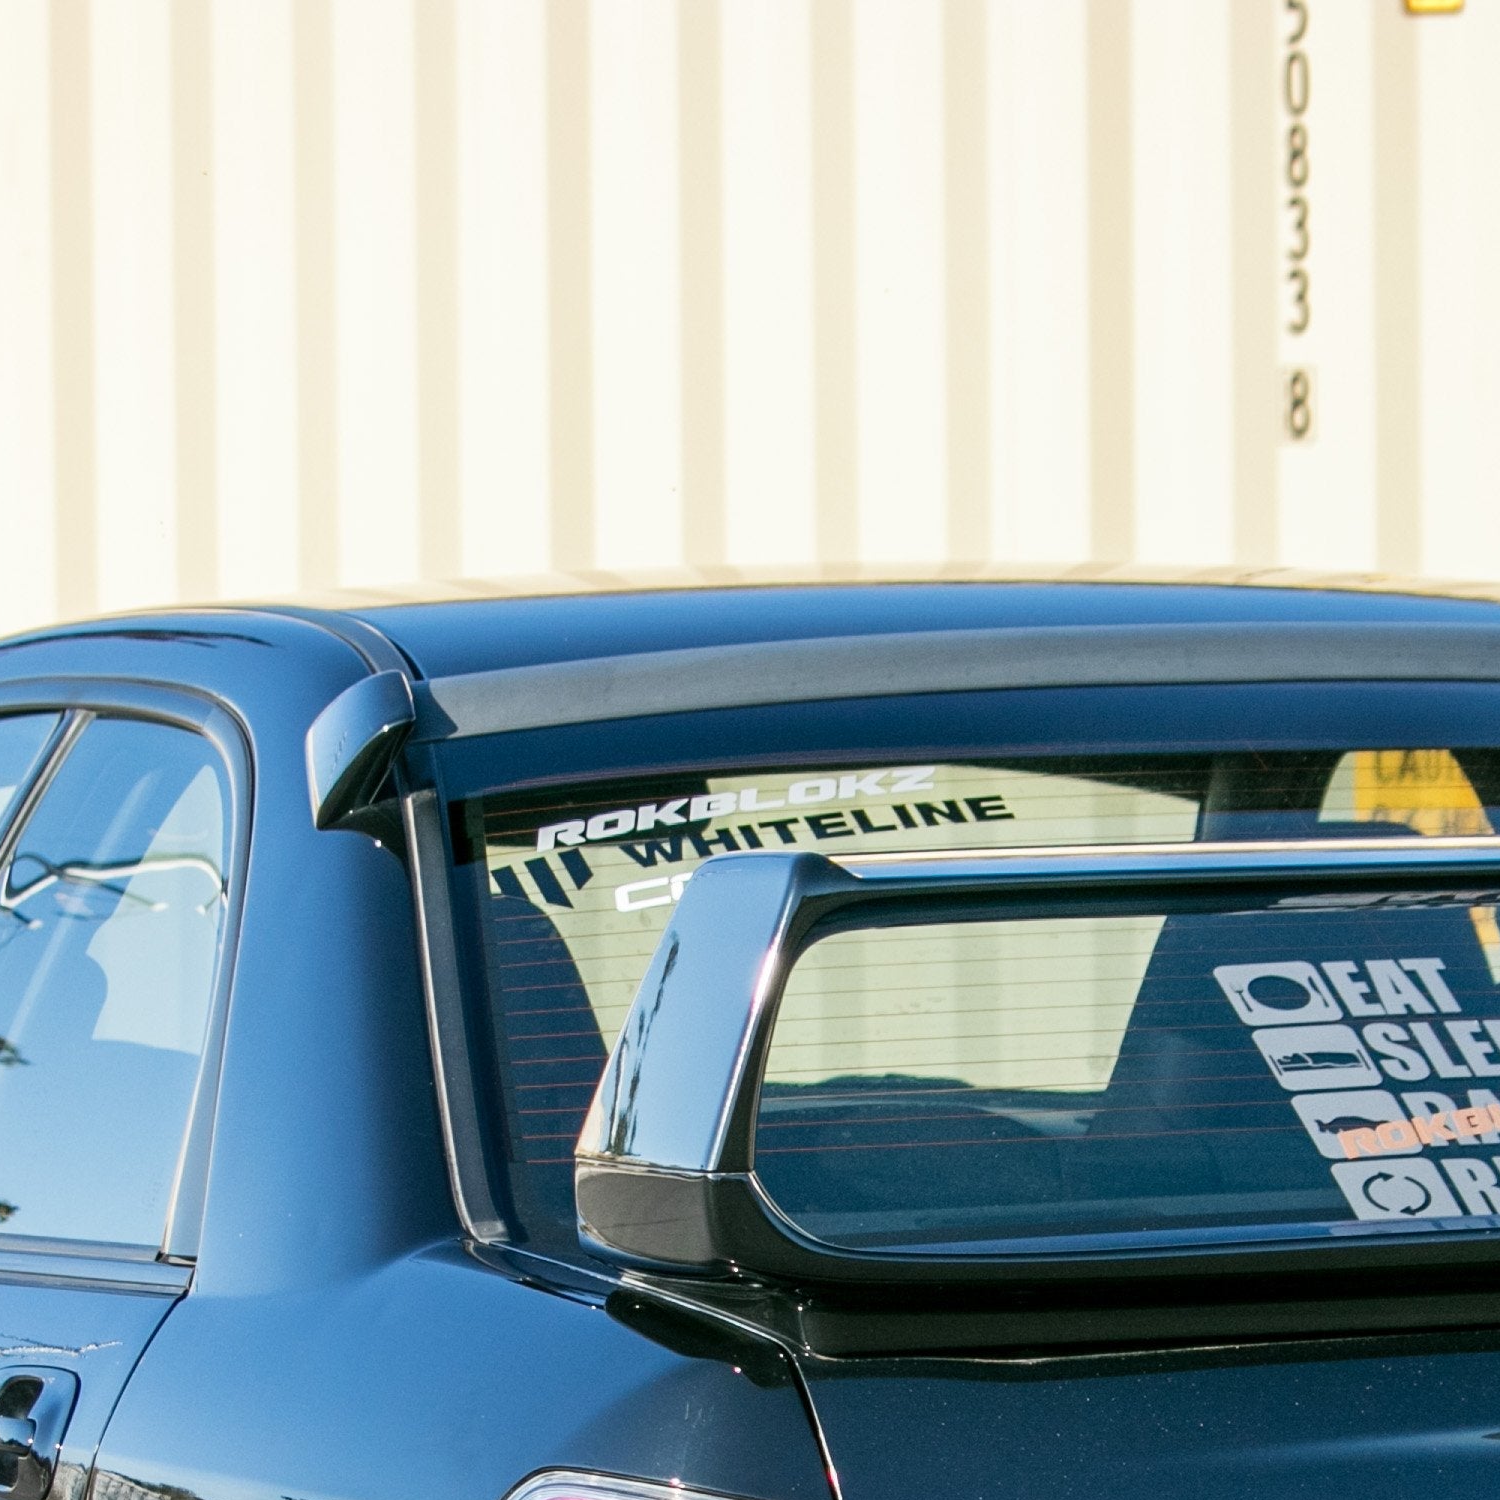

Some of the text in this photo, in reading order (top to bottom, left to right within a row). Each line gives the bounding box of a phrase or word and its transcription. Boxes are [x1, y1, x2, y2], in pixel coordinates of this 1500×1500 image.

[536, 766, 935, 853] ROKBLOKZ
[619, 795, 1015, 868] WHITELINE
[1321, 957, 1461, 1017] EAT
